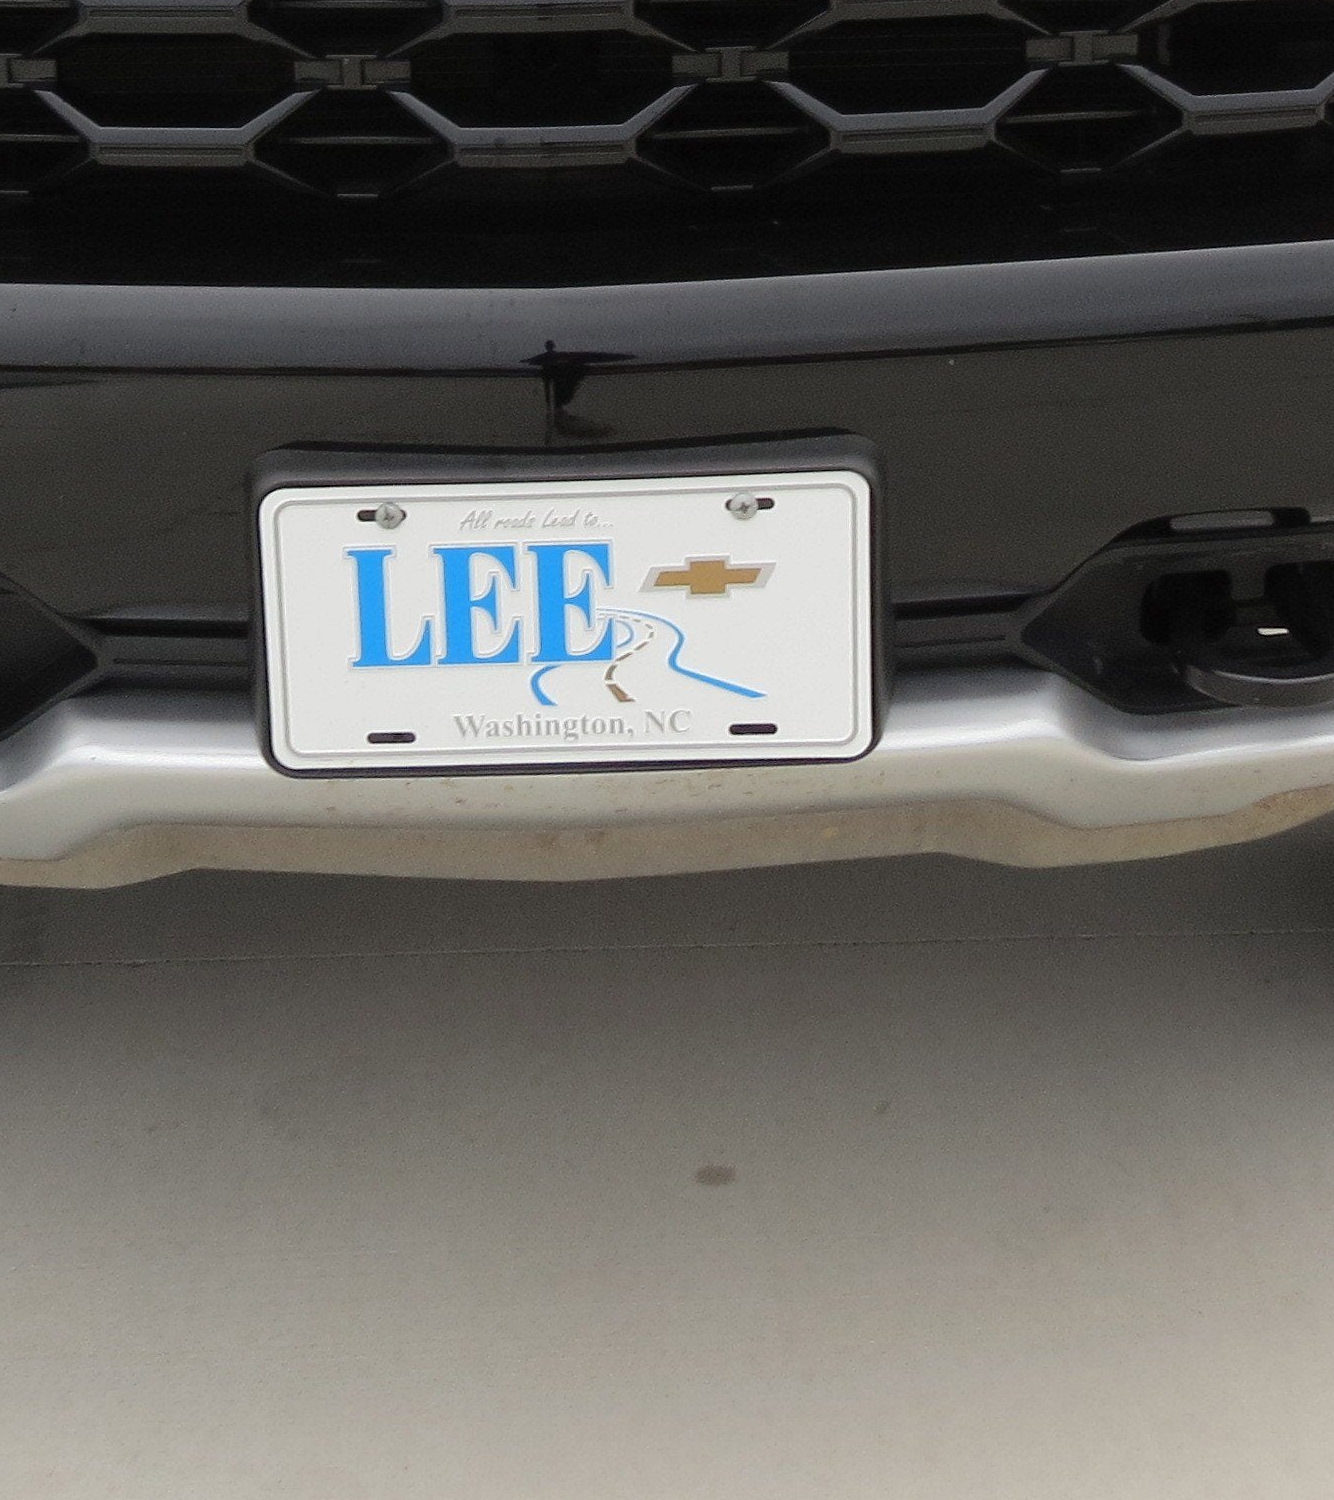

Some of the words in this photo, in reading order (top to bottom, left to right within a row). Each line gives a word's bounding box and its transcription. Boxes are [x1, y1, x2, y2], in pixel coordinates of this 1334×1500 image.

[458, 509, 493, 531] All
[343, 538, 615, 671] LEE
[453, 713, 635, 741] Washington,
[644, 709, 692, 734] NC
